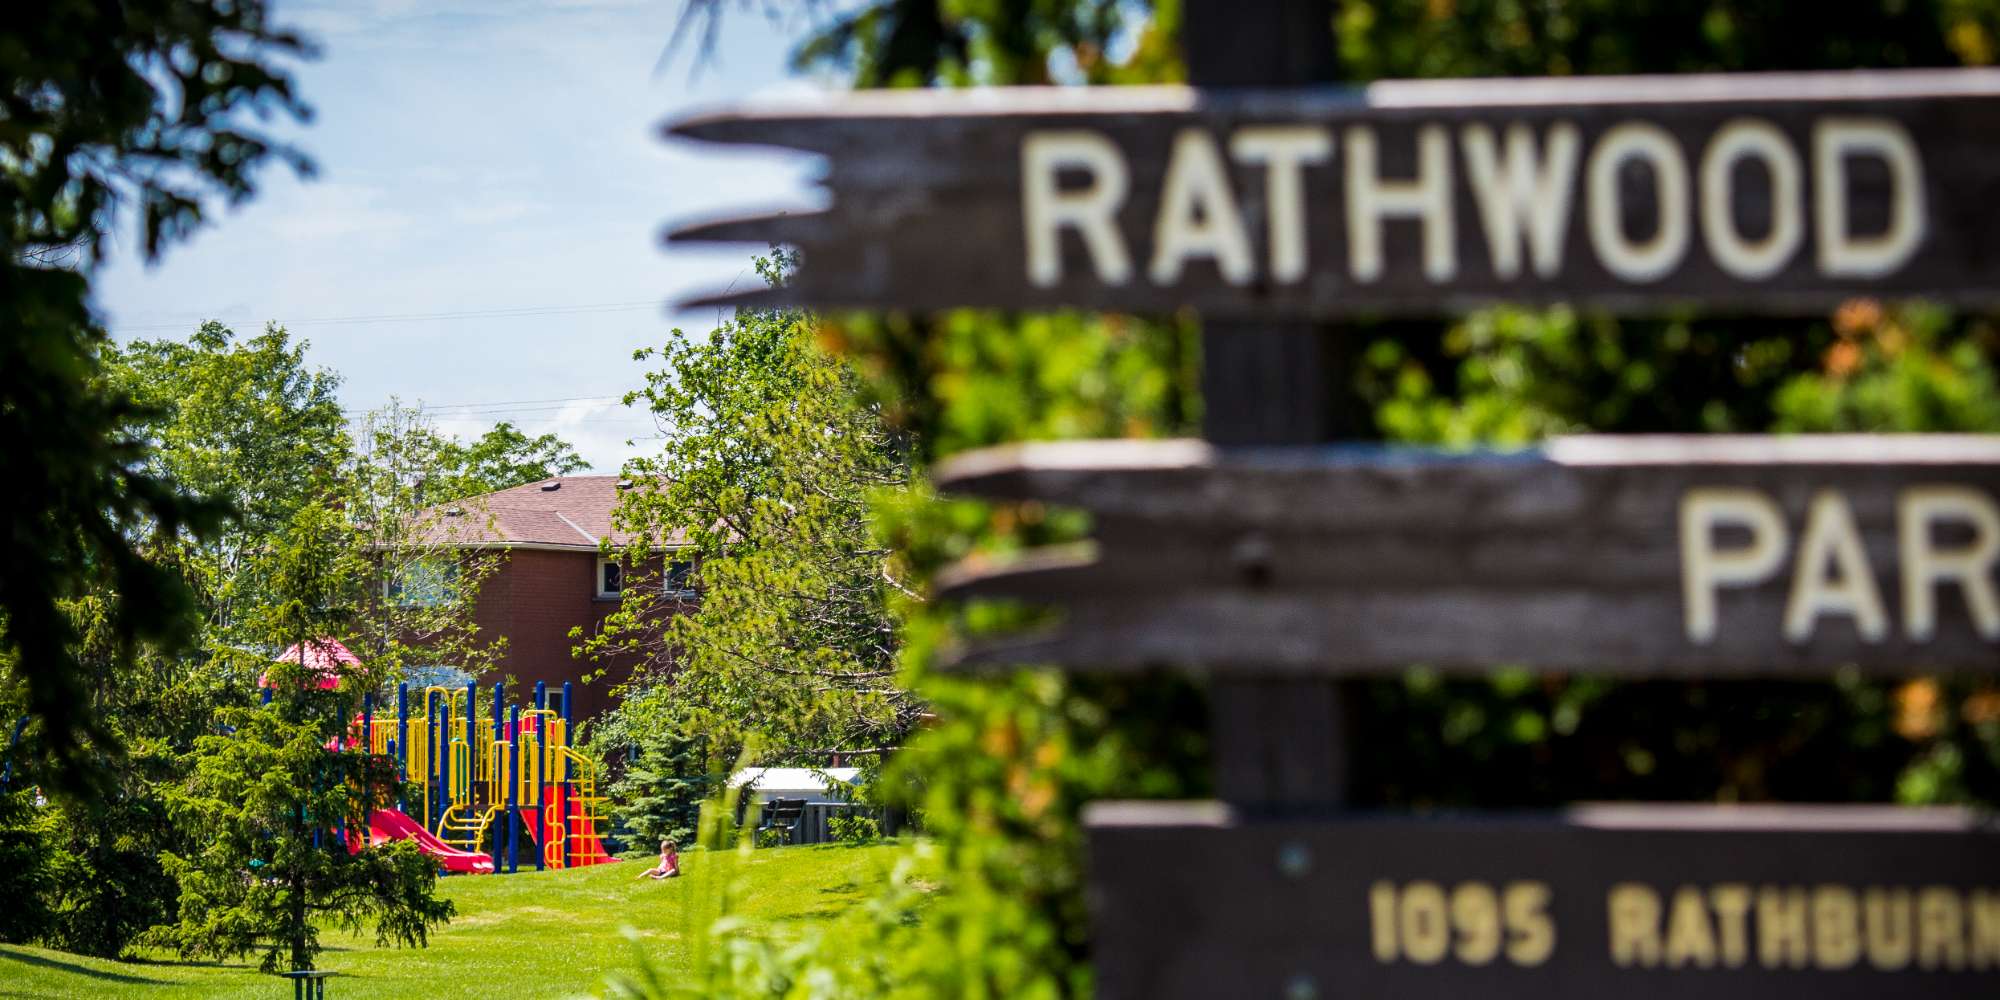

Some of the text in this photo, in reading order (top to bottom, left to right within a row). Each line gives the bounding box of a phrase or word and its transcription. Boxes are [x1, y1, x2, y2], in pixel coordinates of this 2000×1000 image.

[1021, 118, 1928, 288] RATHWOOD
[1680, 486, 2000, 642] PAR
[1369, 880, 1555, 966] 1095
